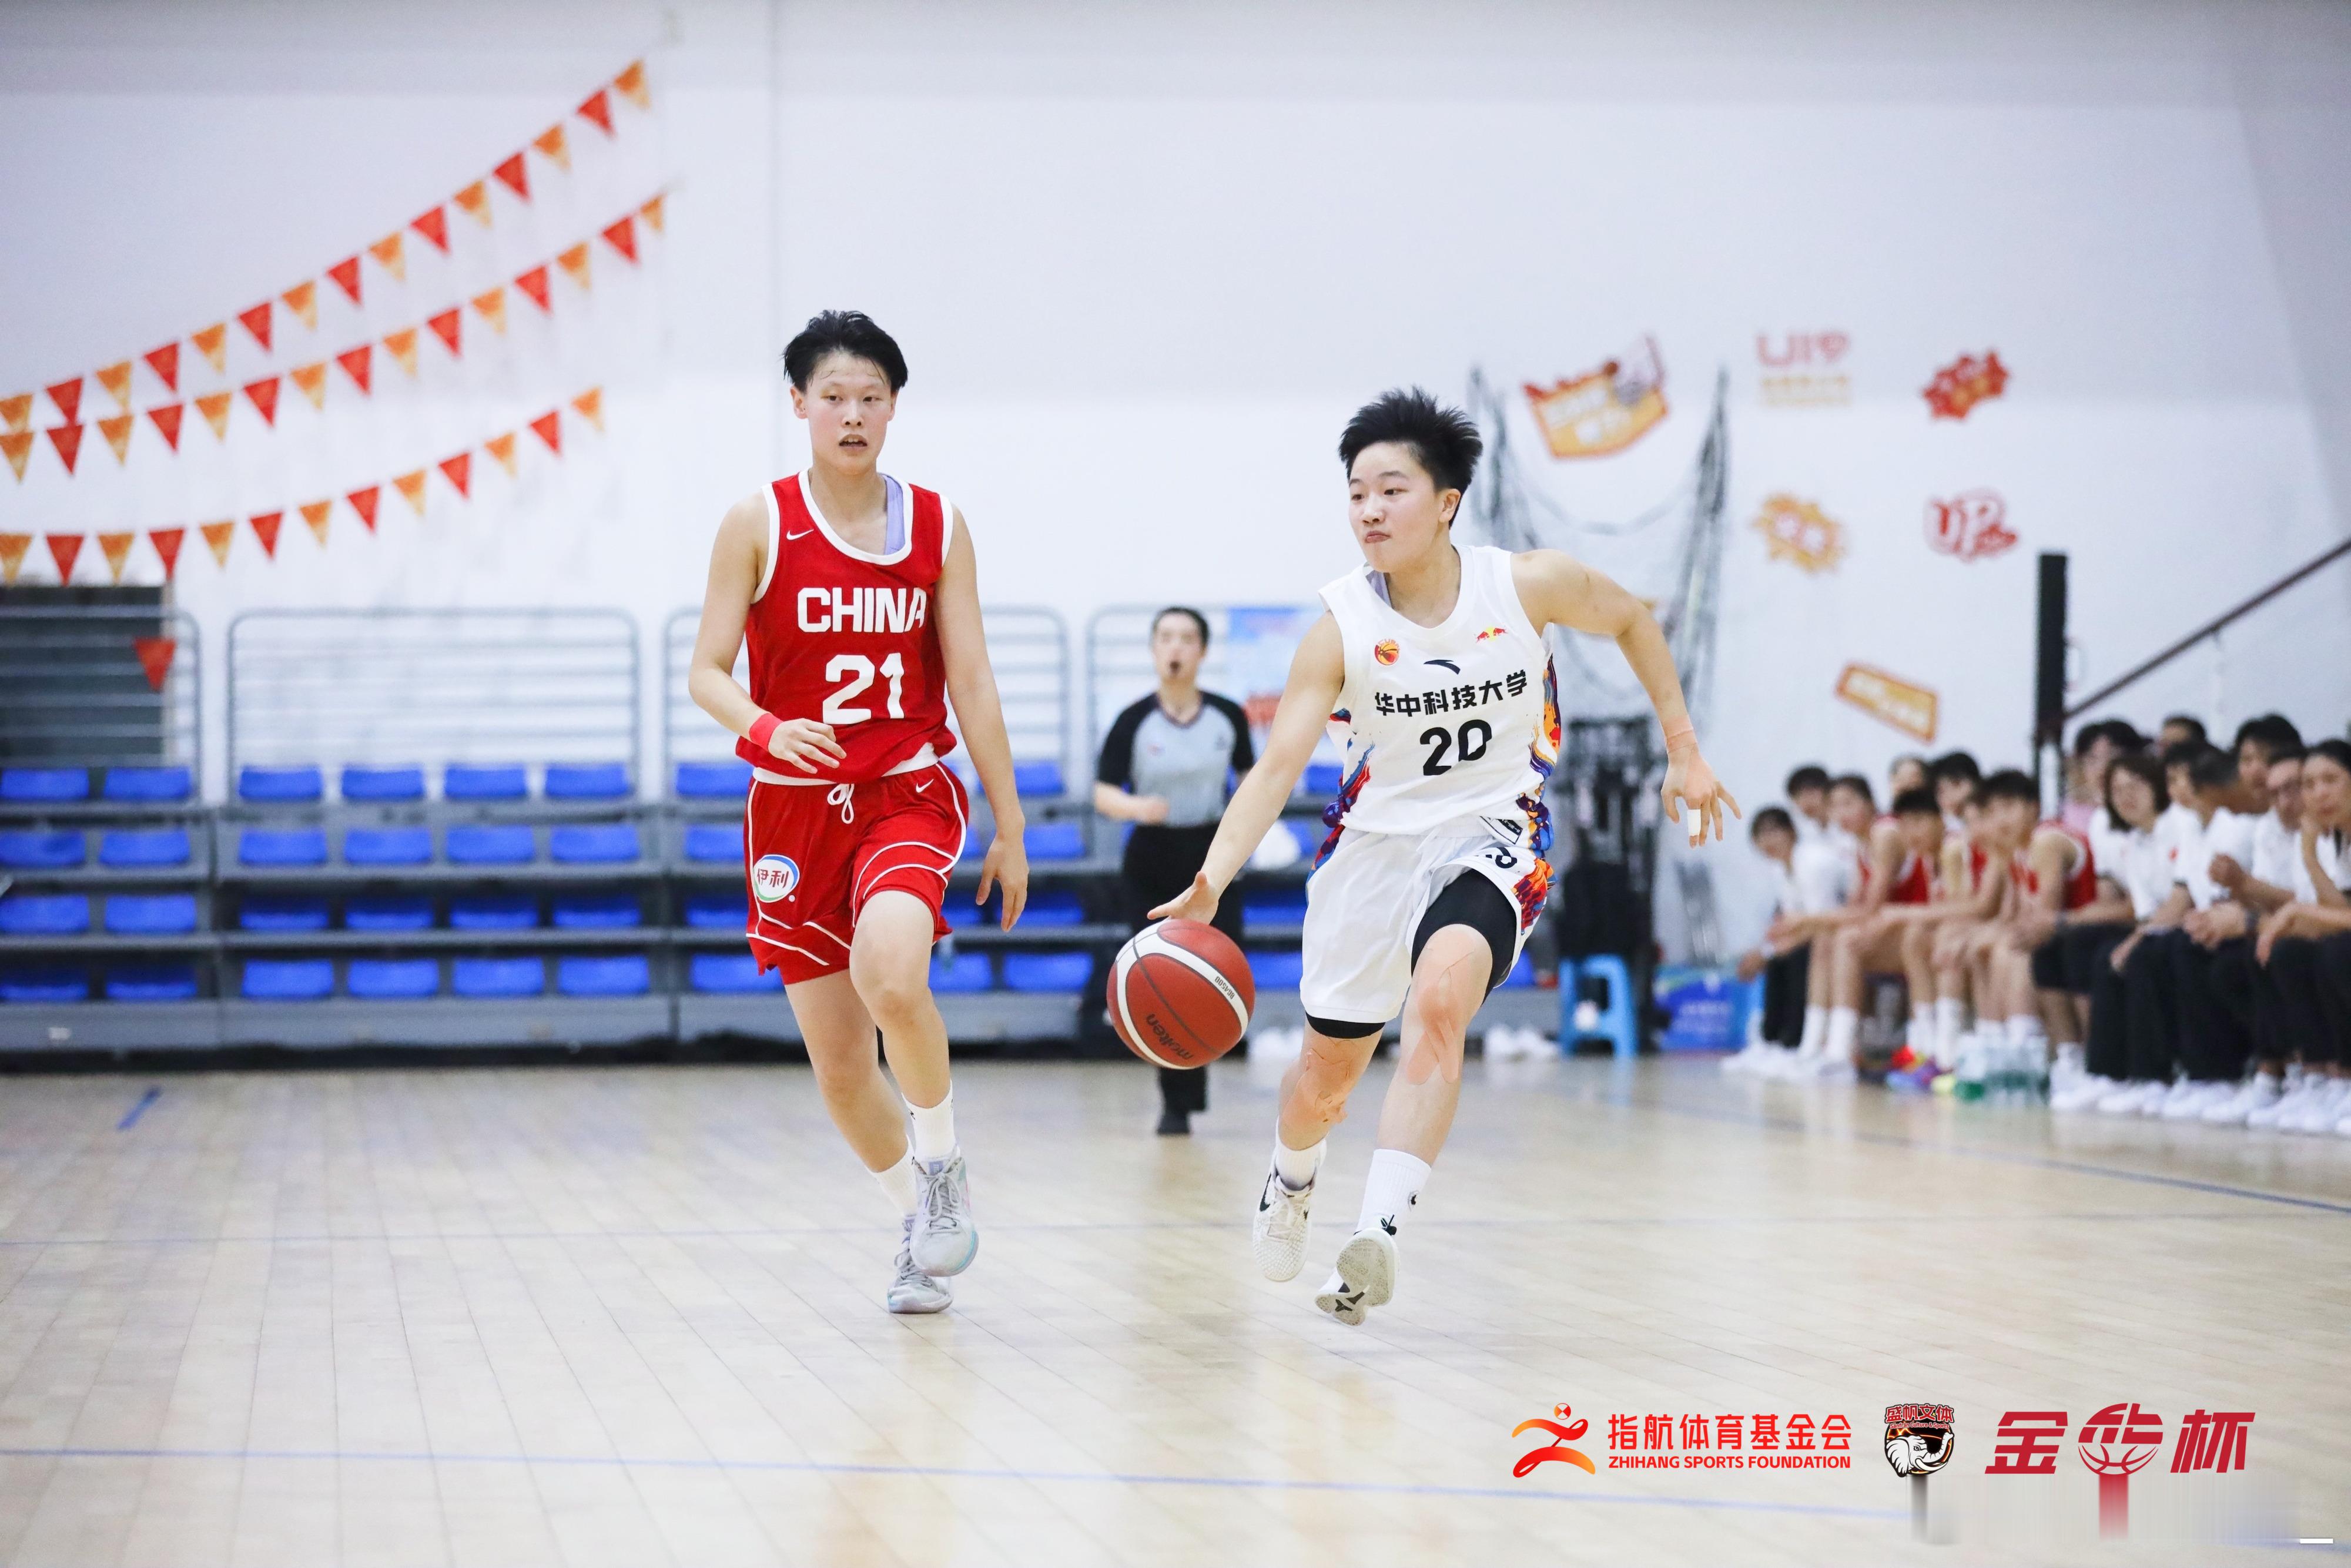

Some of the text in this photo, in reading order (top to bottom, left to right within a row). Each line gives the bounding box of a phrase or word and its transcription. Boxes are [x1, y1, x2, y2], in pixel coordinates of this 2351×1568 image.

[797, 587, 927, 633] CHINA
[823, 652, 905, 725] 21
[1374, 669, 1528, 717] 华中科技大学
[1419, 719, 1492, 776] 20
[757, 868, 789, 888] 伊利
[1214, 976, 1235, 1000] BG4500
[1146, 1014, 1194, 1060] molten
